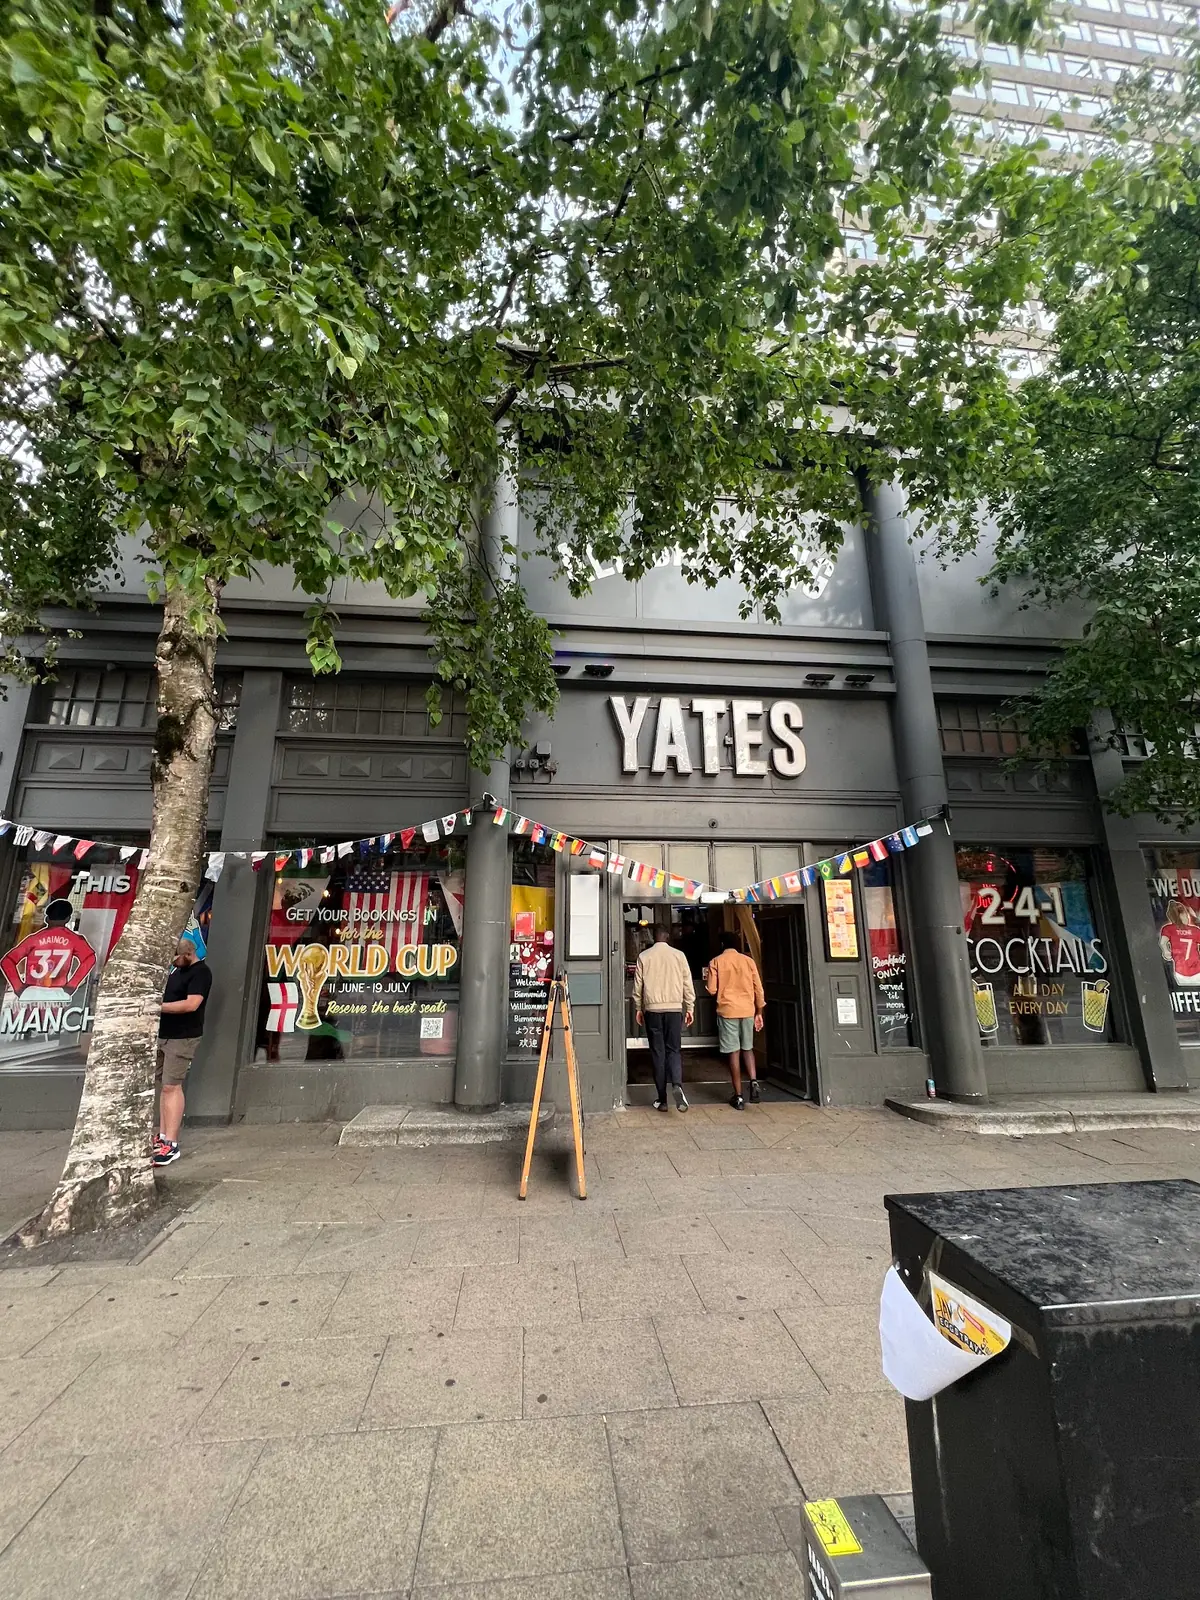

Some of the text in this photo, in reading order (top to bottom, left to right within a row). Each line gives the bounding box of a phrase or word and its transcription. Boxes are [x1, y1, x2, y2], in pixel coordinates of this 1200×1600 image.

[609, 696, 807, 779] YATES
[71, 875, 130, 893] THIS
[1152, 878, 1178, 897] WE
[978, 887, 1066, 925] 2-4-1
[286, 906, 437, 924] GET YOUR BOOKINGS IN
[39, 935, 70, 947] MAINOO
[340, 924, 384, 942] for the
[1180, 938, 1193, 961] 7
[30, 949, 71, 979] 37
[396, 943, 458, 978] CUP
[872, 953, 907, 969] Breakfast
[329, 982, 336, 993] 11
[338, 982, 365, 993] JUNE
[372, 982, 383, 993] 19
[383, 982, 411, 993] JULY
[515, 978, 545, 987] Welcome
[879, 982, 904, 990] served
[1042, 984, 1065, 996] DAY
[514, 990, 547, 998] Bienvenido
[1169, 991, 1200, 1012] IFFE
[325, 999, 448, 1016] Reserve the best seats
[1009, 1002, 1069, 1015] EVERY DAY
[514, 1014, 545, 1022] Bienvenue
[515, 1025, 542, 1035] ようこそ
